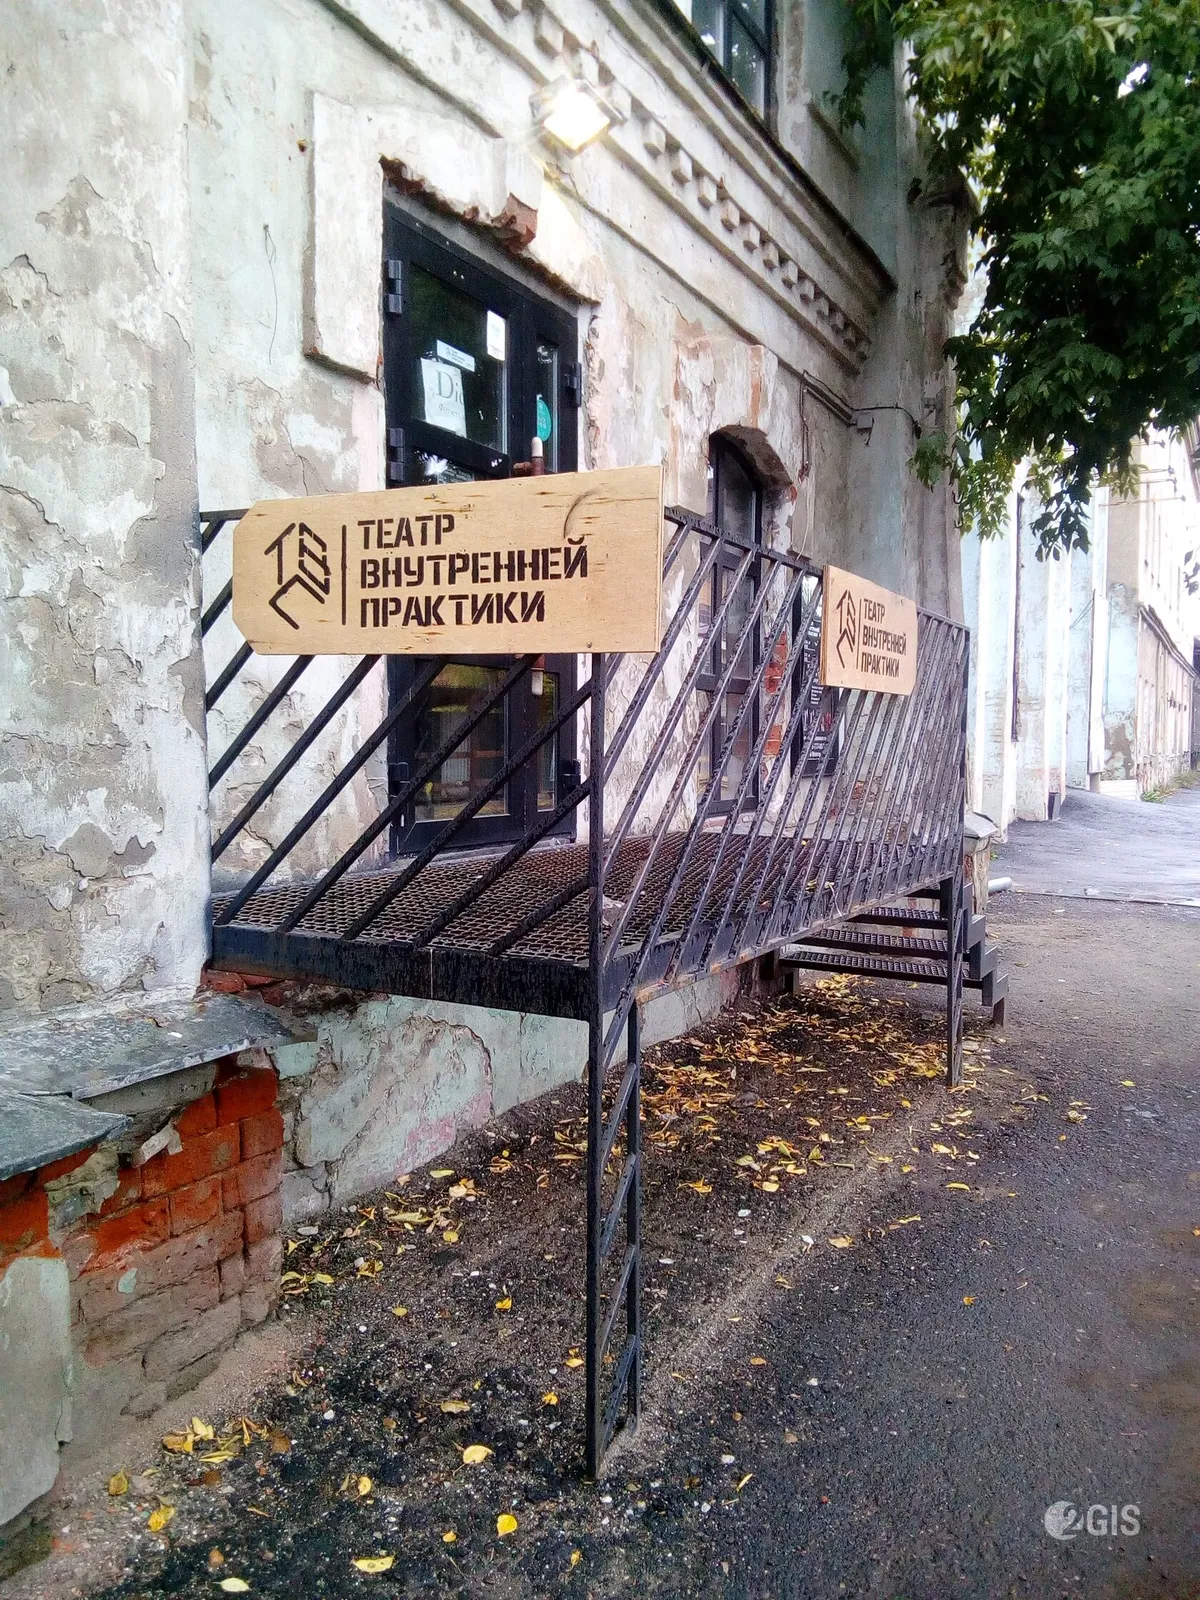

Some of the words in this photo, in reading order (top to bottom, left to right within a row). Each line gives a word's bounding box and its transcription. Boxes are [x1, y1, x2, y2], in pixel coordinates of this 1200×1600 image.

[357, 514, 455, 550] ТЕАТР
[360, 536, 588, 589] ВНУТРЕННЕЙ
[360, 590, 545, 628] ПРАКТИКИ
[863, 598, 886, 624] ТЕАТР
[862, 625, 907, 656] ВНУТРЕННЕЙ
[860, 652, 900, 677] ПРАКТИКИ
